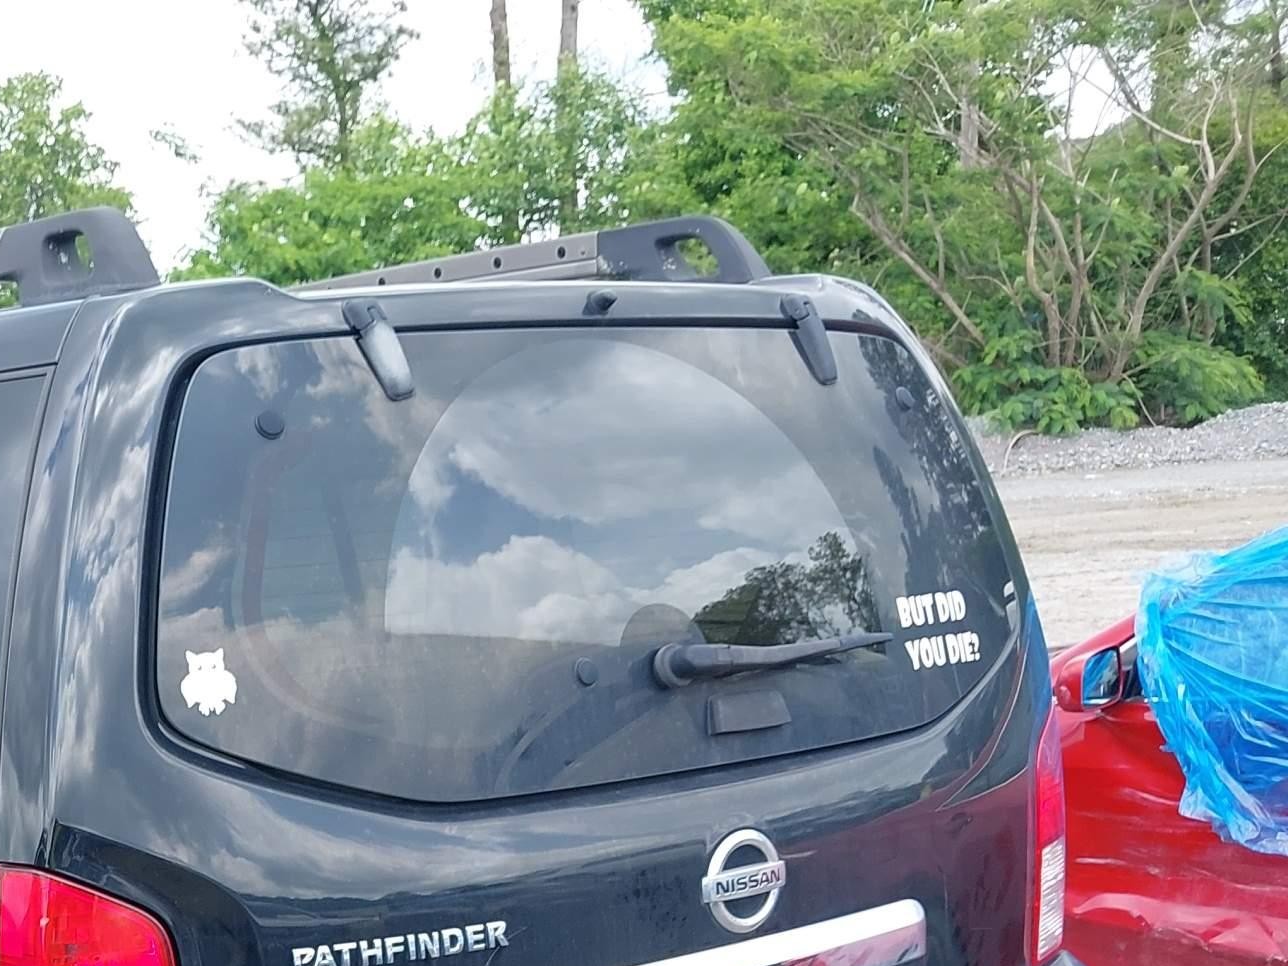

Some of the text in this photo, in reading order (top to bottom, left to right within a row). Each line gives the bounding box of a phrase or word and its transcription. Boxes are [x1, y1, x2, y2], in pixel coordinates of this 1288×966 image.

[895, 590, 967, 628] BUT DID
[904, 631, 981, 671] YOU DIE?
[715, 868, 780, 896] NISSAN
